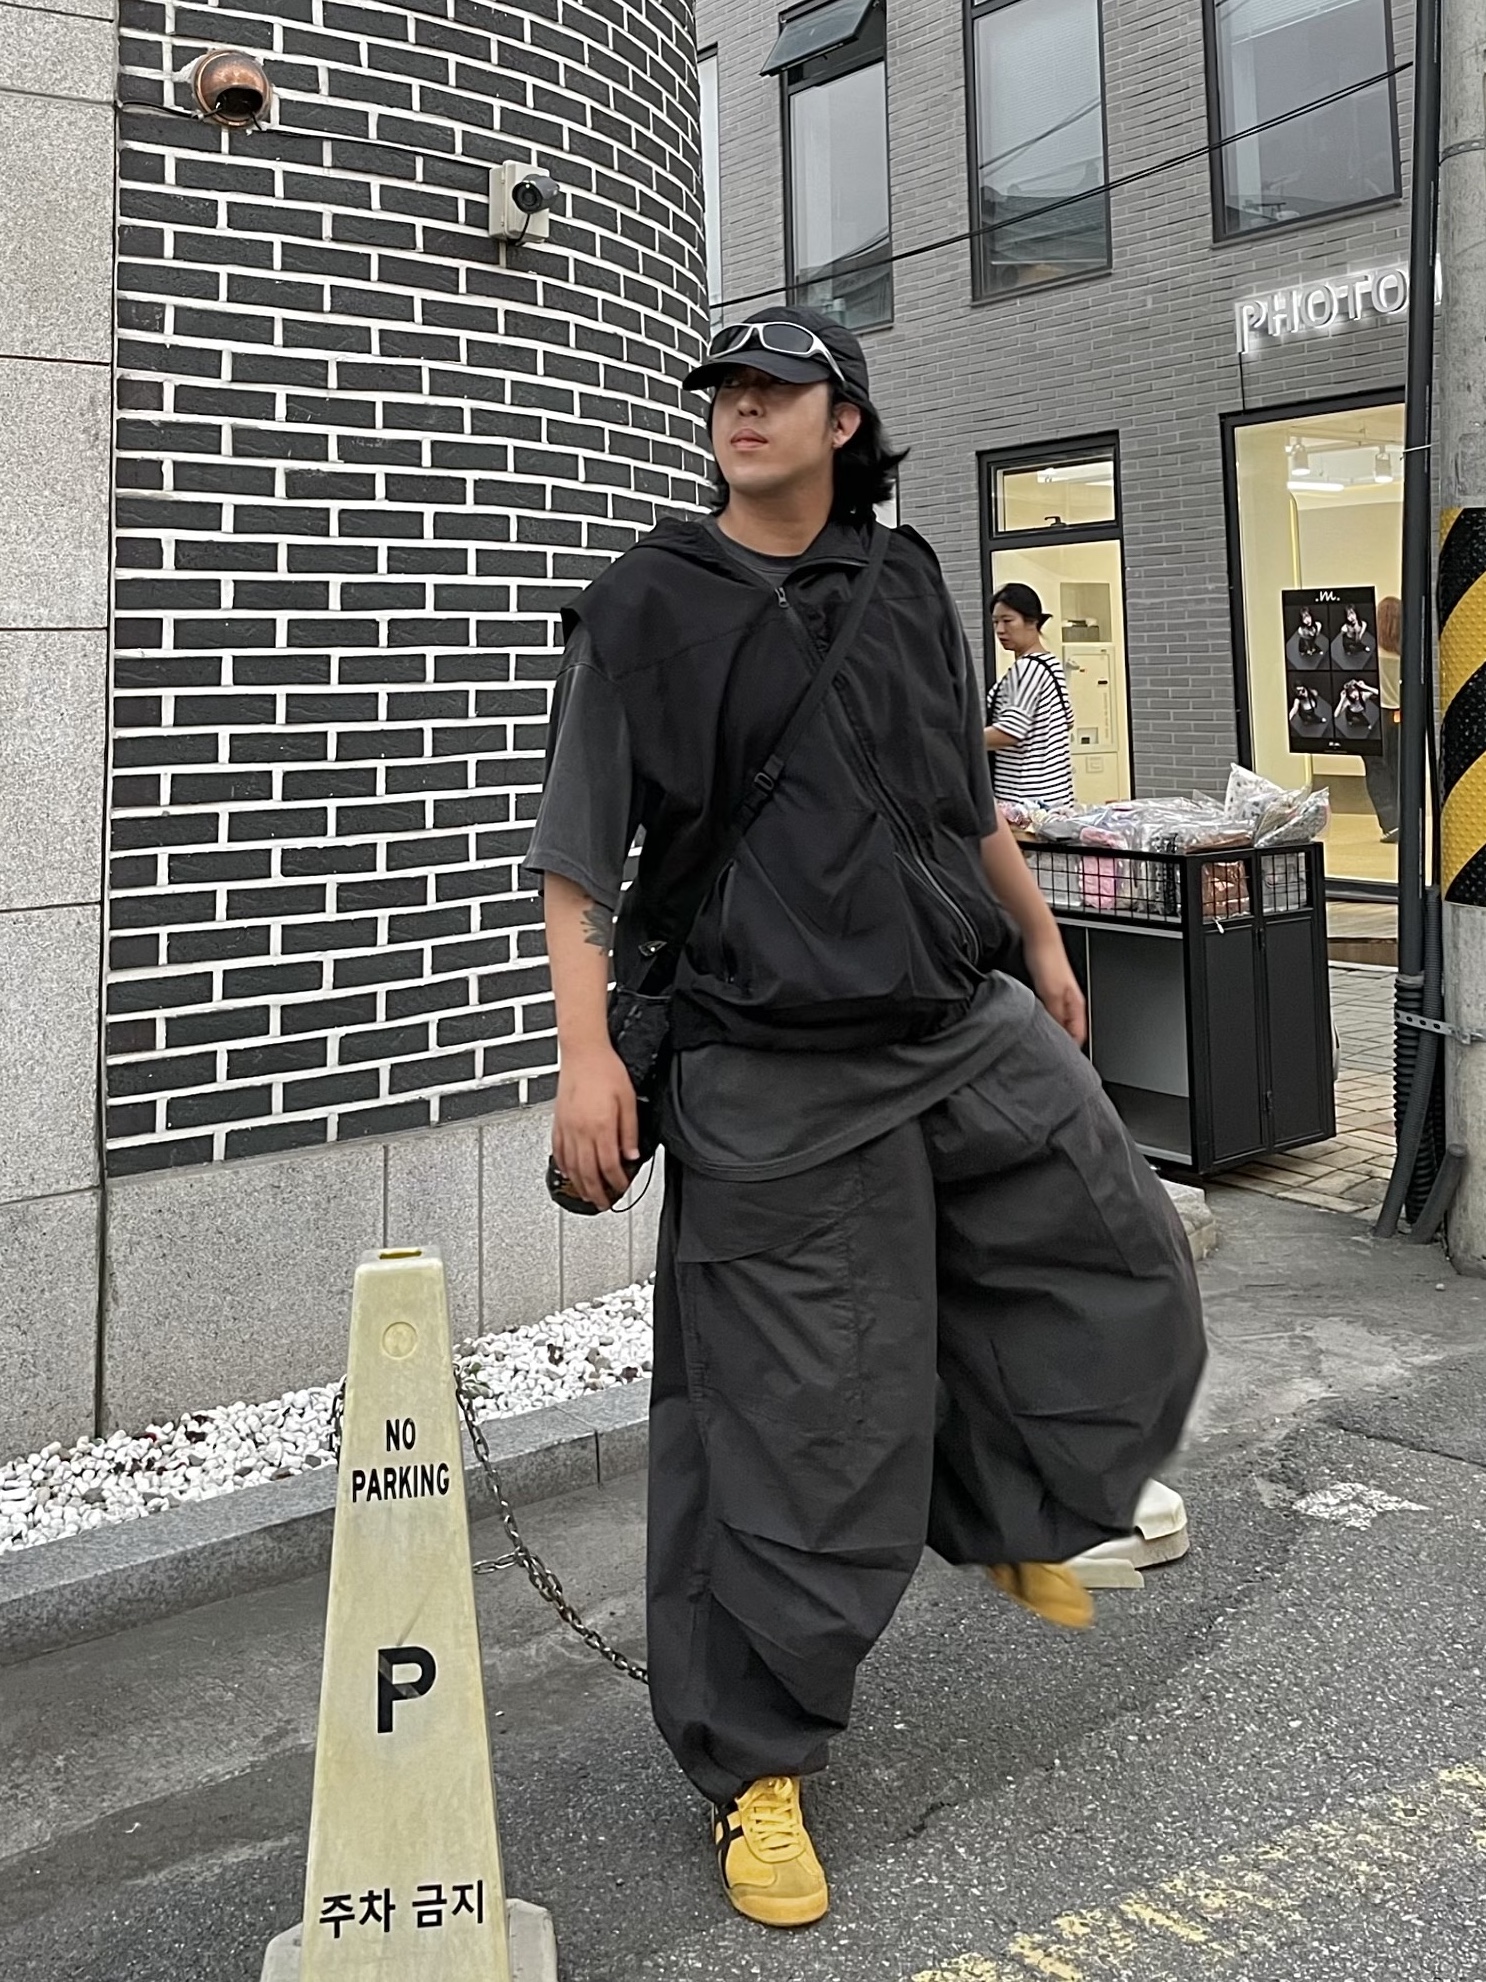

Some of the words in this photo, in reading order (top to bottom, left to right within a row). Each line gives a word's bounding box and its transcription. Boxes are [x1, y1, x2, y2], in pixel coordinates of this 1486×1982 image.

[1235, 256, 1443, 355] PHOTO
[386, 1418, 416, 1451] NO
[352, 1463, 450, 1503] PARKING
[378, 1646, 436, 1733] P
[319, 1887, 396, 1939] 주차
[412, 1880, 483, 1929] 금지
